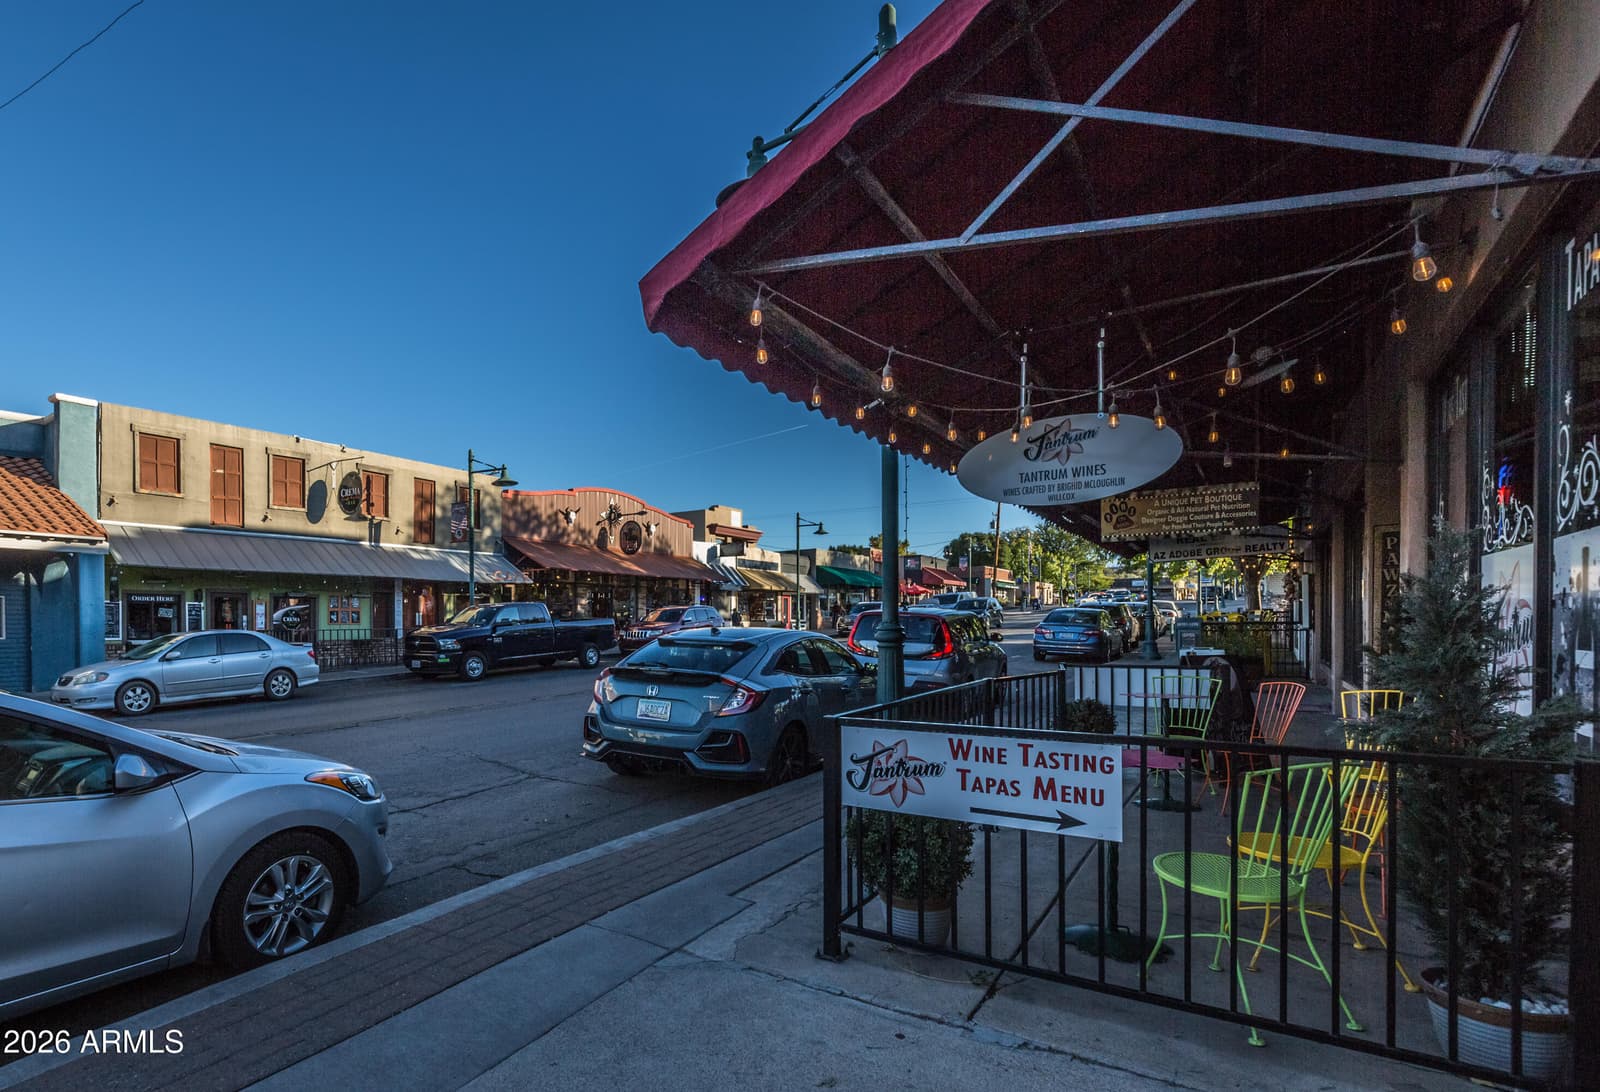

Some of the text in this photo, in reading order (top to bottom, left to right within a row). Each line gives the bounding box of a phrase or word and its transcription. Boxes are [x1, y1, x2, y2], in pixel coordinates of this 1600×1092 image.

[1023, 426, 1099, 462] Tantrum
[1002, 477, 1126, 497] WINES CRAFTED BY BRIGHID MCLOUGHLIN
[1018, 463, 1107, 484] TANTRUM WINES
[1047, 492, 1075, 503] WILLCOX
[1153, 493, 1243, 508] A UNIQUE PET BOUTIQUE
[1153, 551, 1166, 560] AZ
[1169, 547, 1203, 559] ADOBE
[1244, 541, 1286, 553] REALTY
[1383, 536, 1399, 597] PAWZ
[846, 746, 946, 793] Tantrum
[947, 738, 1115, 775] WINE TASTING
[956, 768, 1105, 807] TAPAS MENU
